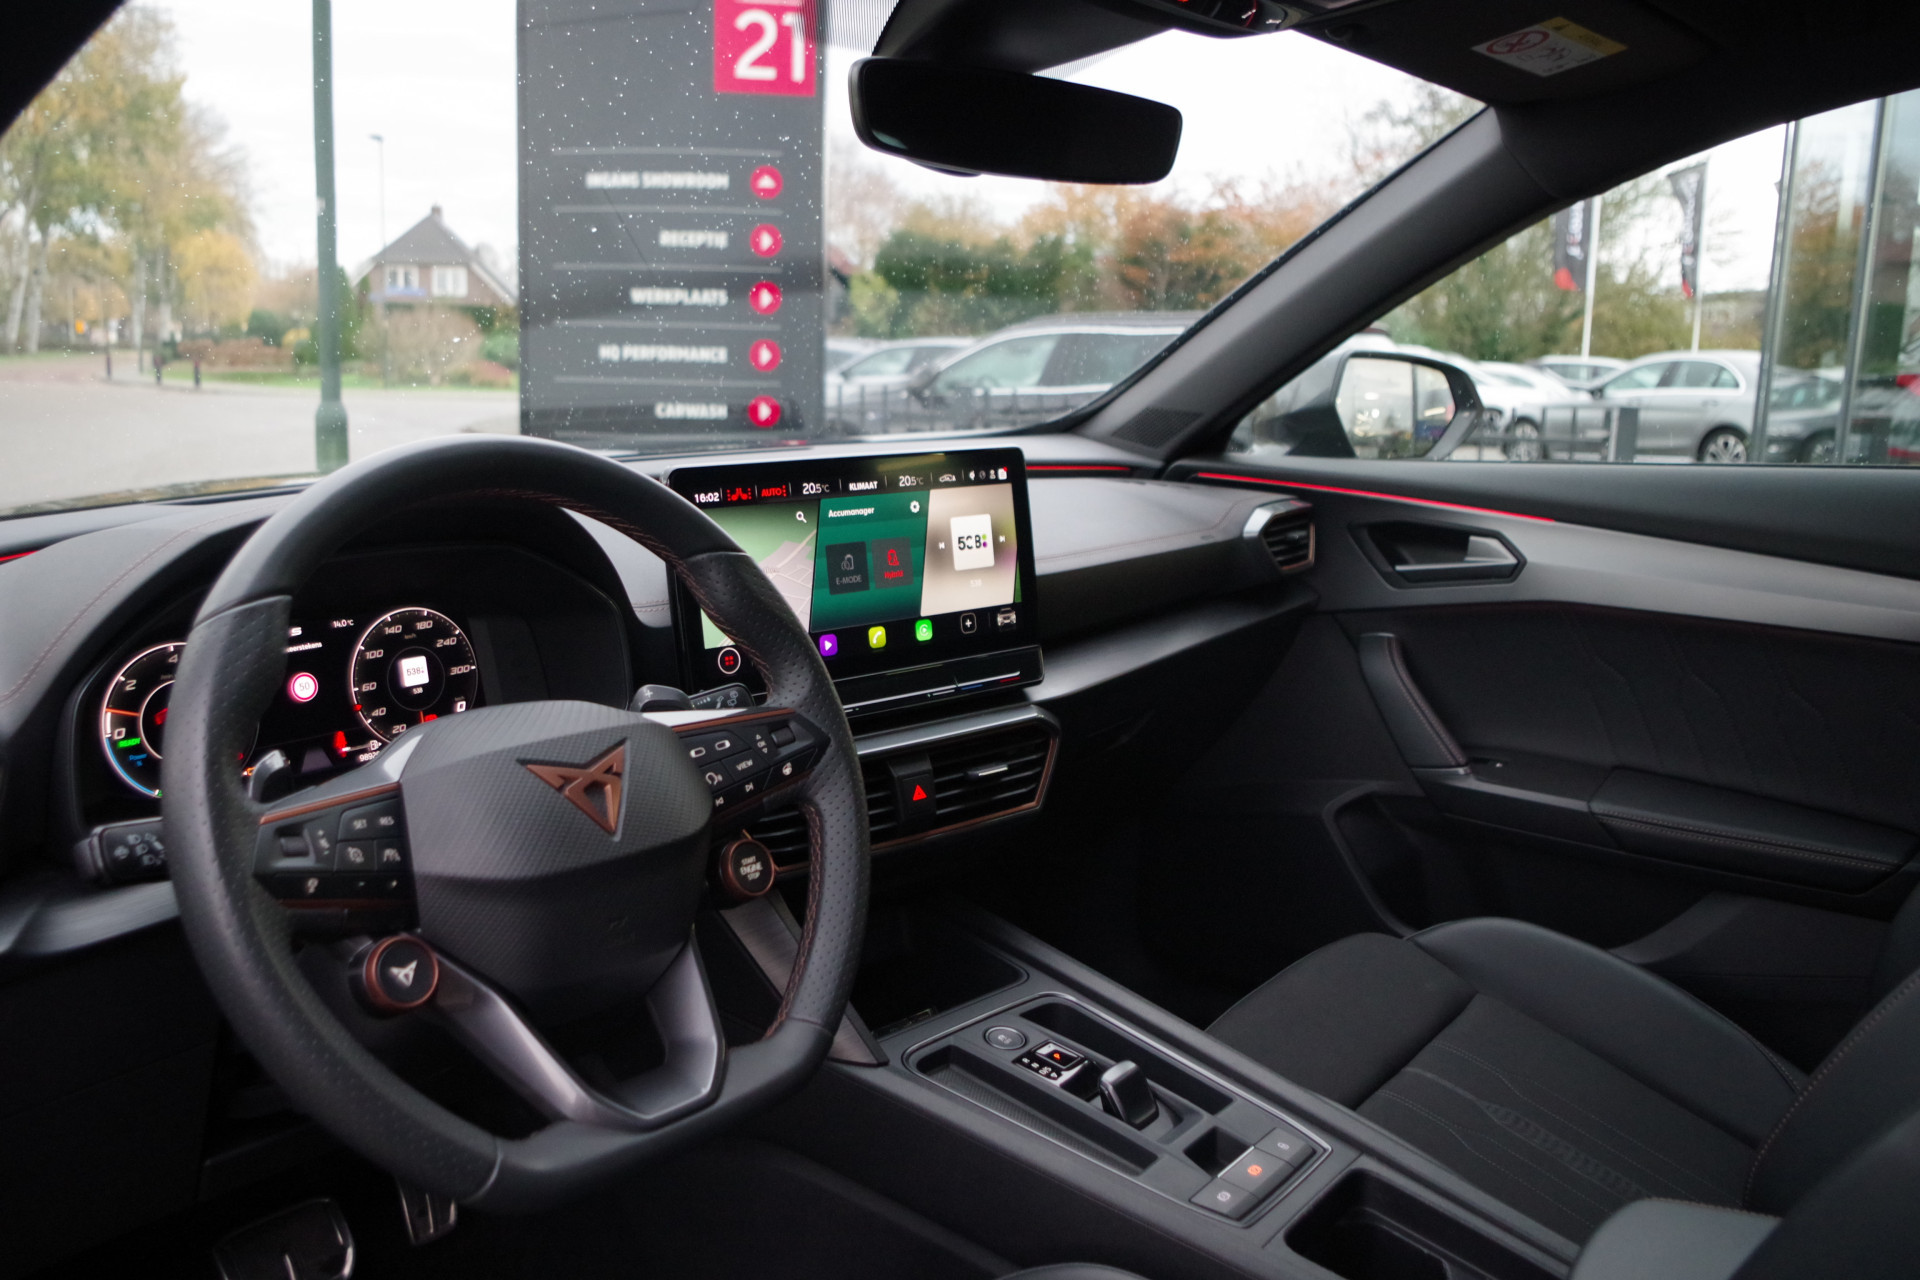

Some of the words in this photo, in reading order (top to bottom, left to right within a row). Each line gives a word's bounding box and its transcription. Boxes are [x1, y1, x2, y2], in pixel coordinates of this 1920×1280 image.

[735, 8, 806, 83] 21
[585, 171, 639, 190] INGANG
[641, 171, 730, 191] SHOWROOM
[659, 230, 728, 249] RECEPTIE
[629, 287, 728, 307] WERKPLAATS
[598, 344, 620, 362] HQ
[621, 344, 728, 363] PERFORMANCE
[654, 402, 728, 420] CARWASH
[849, 481, 878, 491] KLIMAAT
[694, 492, 720, 503] 16:02
[761, 487, 783, 497] AUTO
[828, 507, 875, 518] Accumanager
[836, 574, 863, 585] E-MODE
[384, 625, 402, 635] 140
[415, 620, 433, 630] 180
[436, 637, 457, 648] 240
[168, 654, 179, 664] 4
[365, 650, 384, 660] 100
[450, 664, 470, 676] 300
[125, 679, 137, 691] 2
[362, 682, 377, 692] 60
[372, 707, 387, 717] 40
[456, 700, 467, 713] 0
[114, 727, 126, 740] 0
[392, 724, 407, 735] 20
[117, 737, 141, 749] READY
[736, 759, 753, 770] VIEW
[741, 855, 756, 865] START
[740, 861, 763, 875] ENGINE
